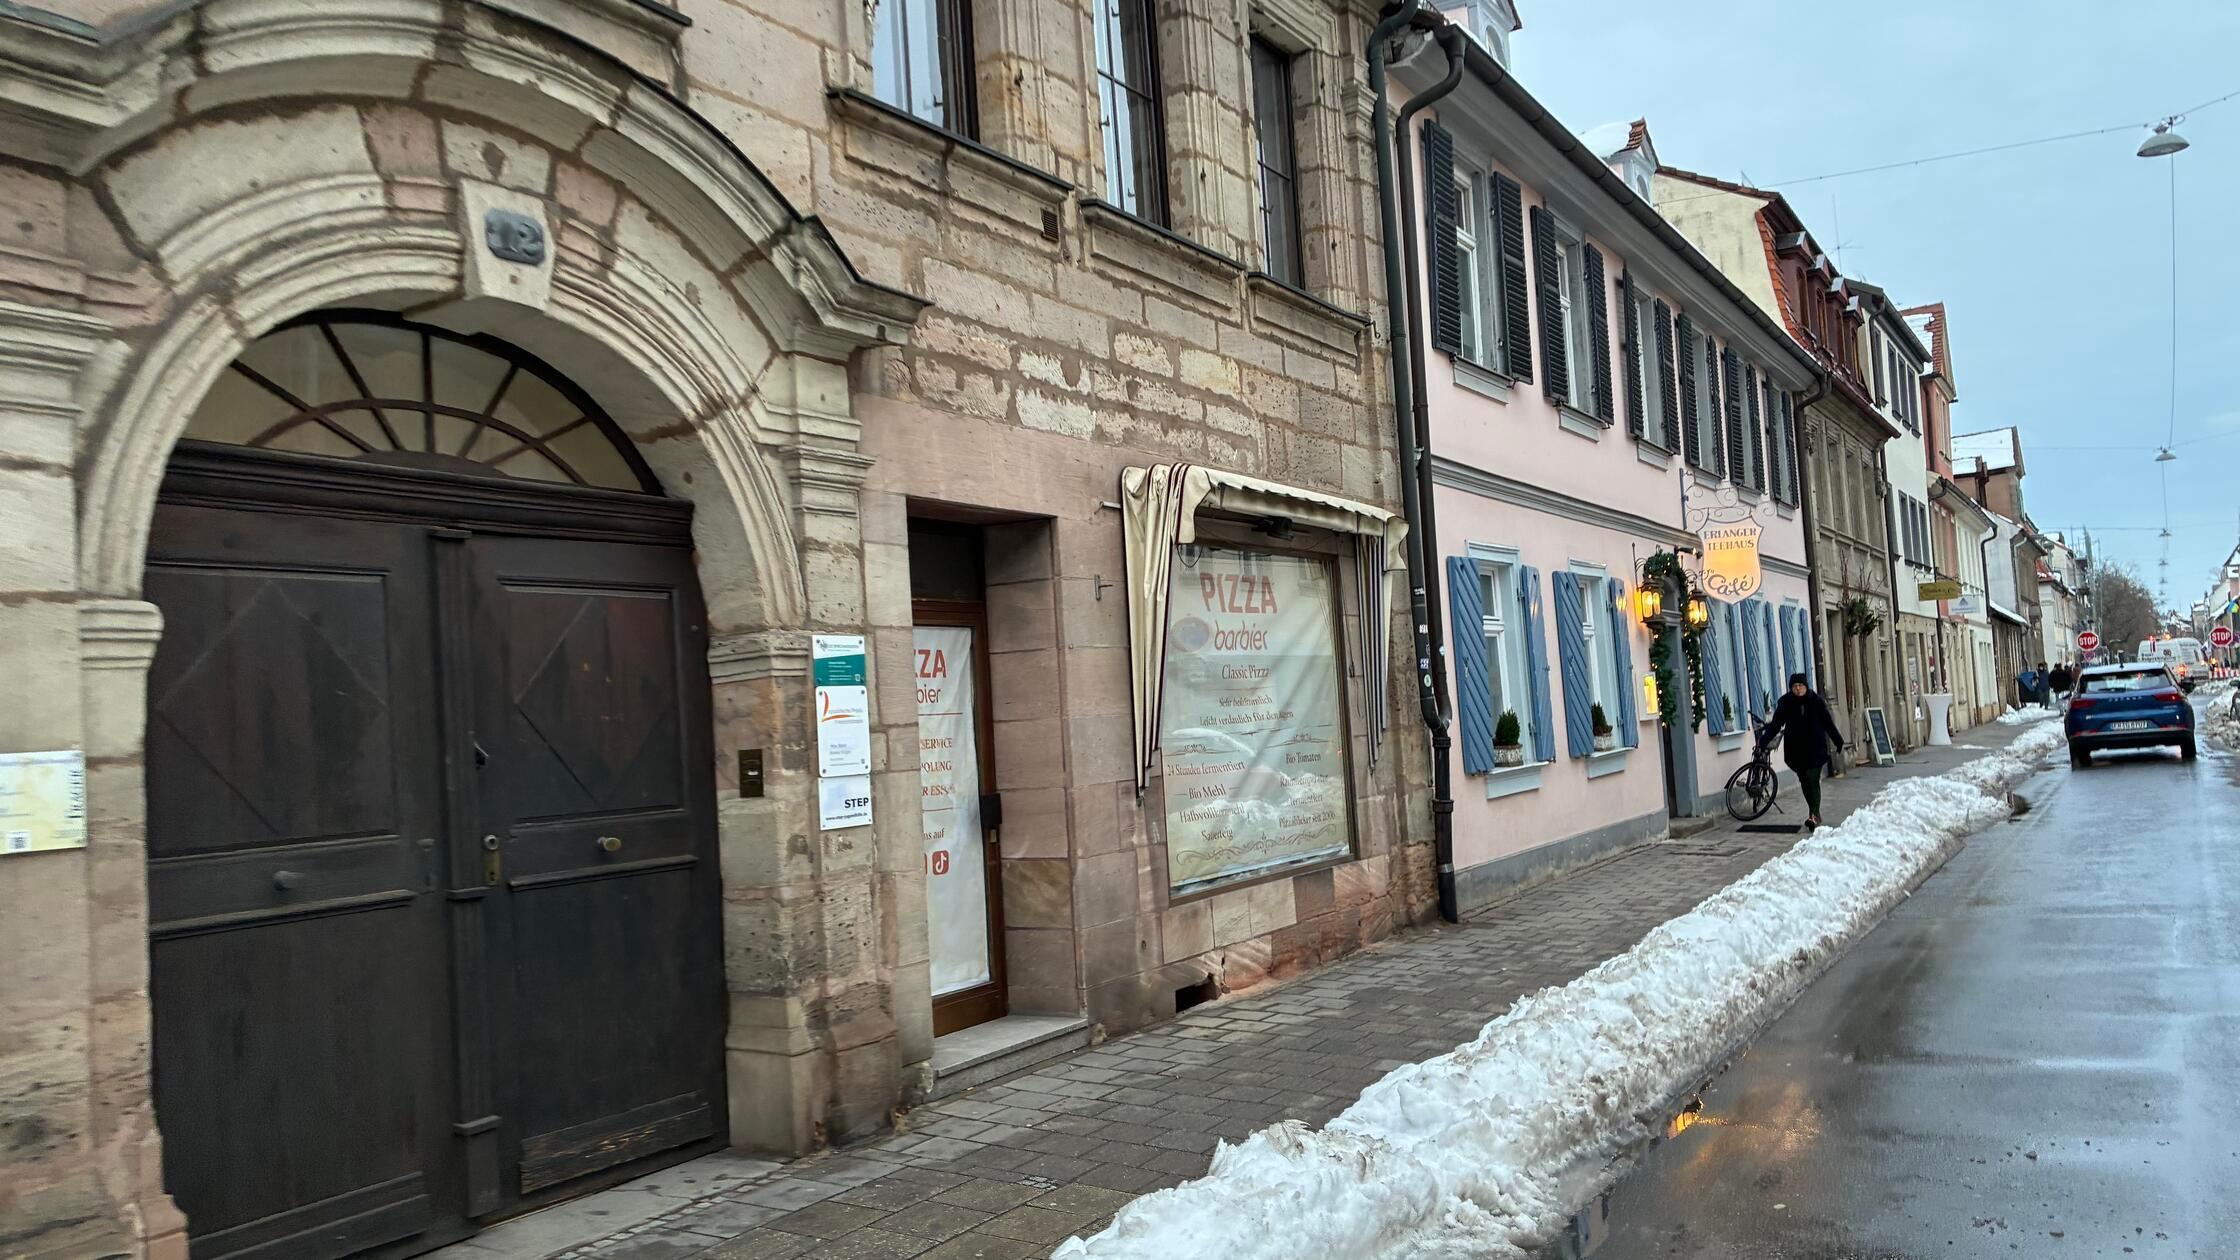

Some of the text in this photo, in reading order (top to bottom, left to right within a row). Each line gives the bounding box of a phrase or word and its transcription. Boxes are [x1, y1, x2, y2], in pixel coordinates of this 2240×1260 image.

[1704, 527, 1757, 539] ERLANGER
[1708, 540, 1754, 551] TEEHAUS
[1200, 572, 1278, 613] PIZZA
[1708, 574, 1754, 595] Café
[1214, 619, 1268, 650] barbier
[2079, 637, 2098, 646] STOP
[2211, 632, 2231, 641] STOP
[913, 649, 947, 678] ZA
[1221, 664, 1248, 680] Classic
[1175, 763, 1201, 777] Stunden
[1201, 760, 1247, 776] fermentiert
[1188, 783, 1227, 800] Bio Mehl
[844, 797, 869, 808] STEP
[933, 828, 945, 839] auf
